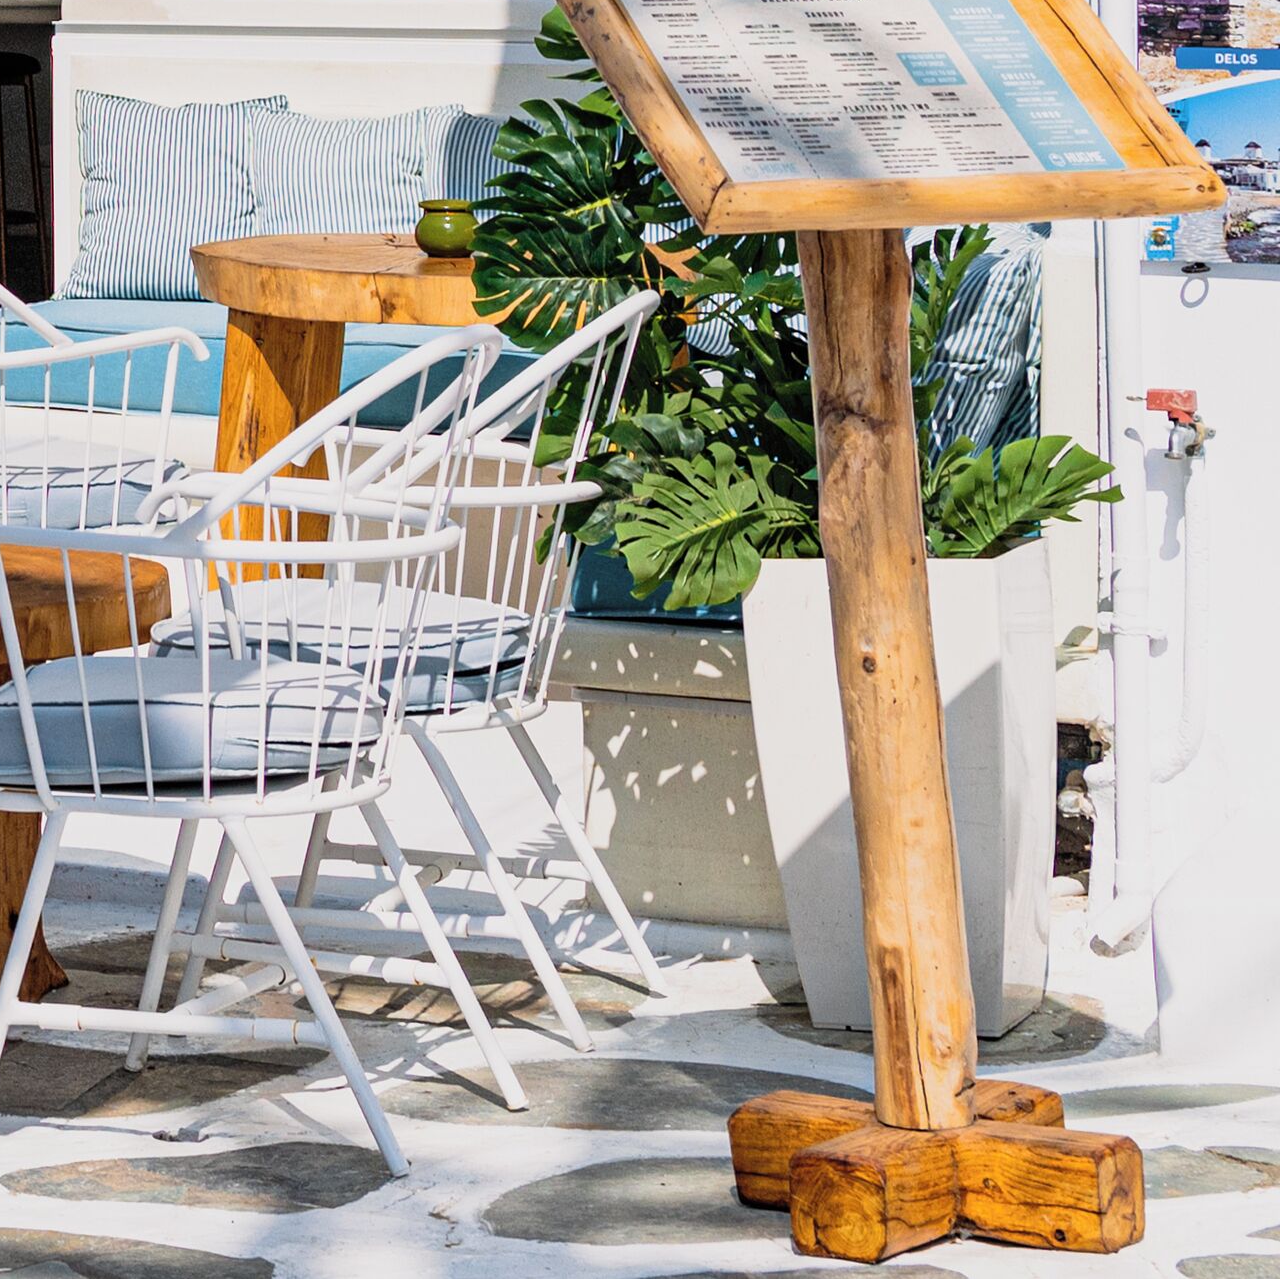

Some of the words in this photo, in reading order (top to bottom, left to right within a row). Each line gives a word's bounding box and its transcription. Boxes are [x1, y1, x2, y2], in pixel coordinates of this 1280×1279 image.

[1215, 52, 1259, 65] DELOS
[842, 104, 889, 113] PLATTERS
[891, 103, 908, 112] FOR
[911, 102, 930, 111] TWO
